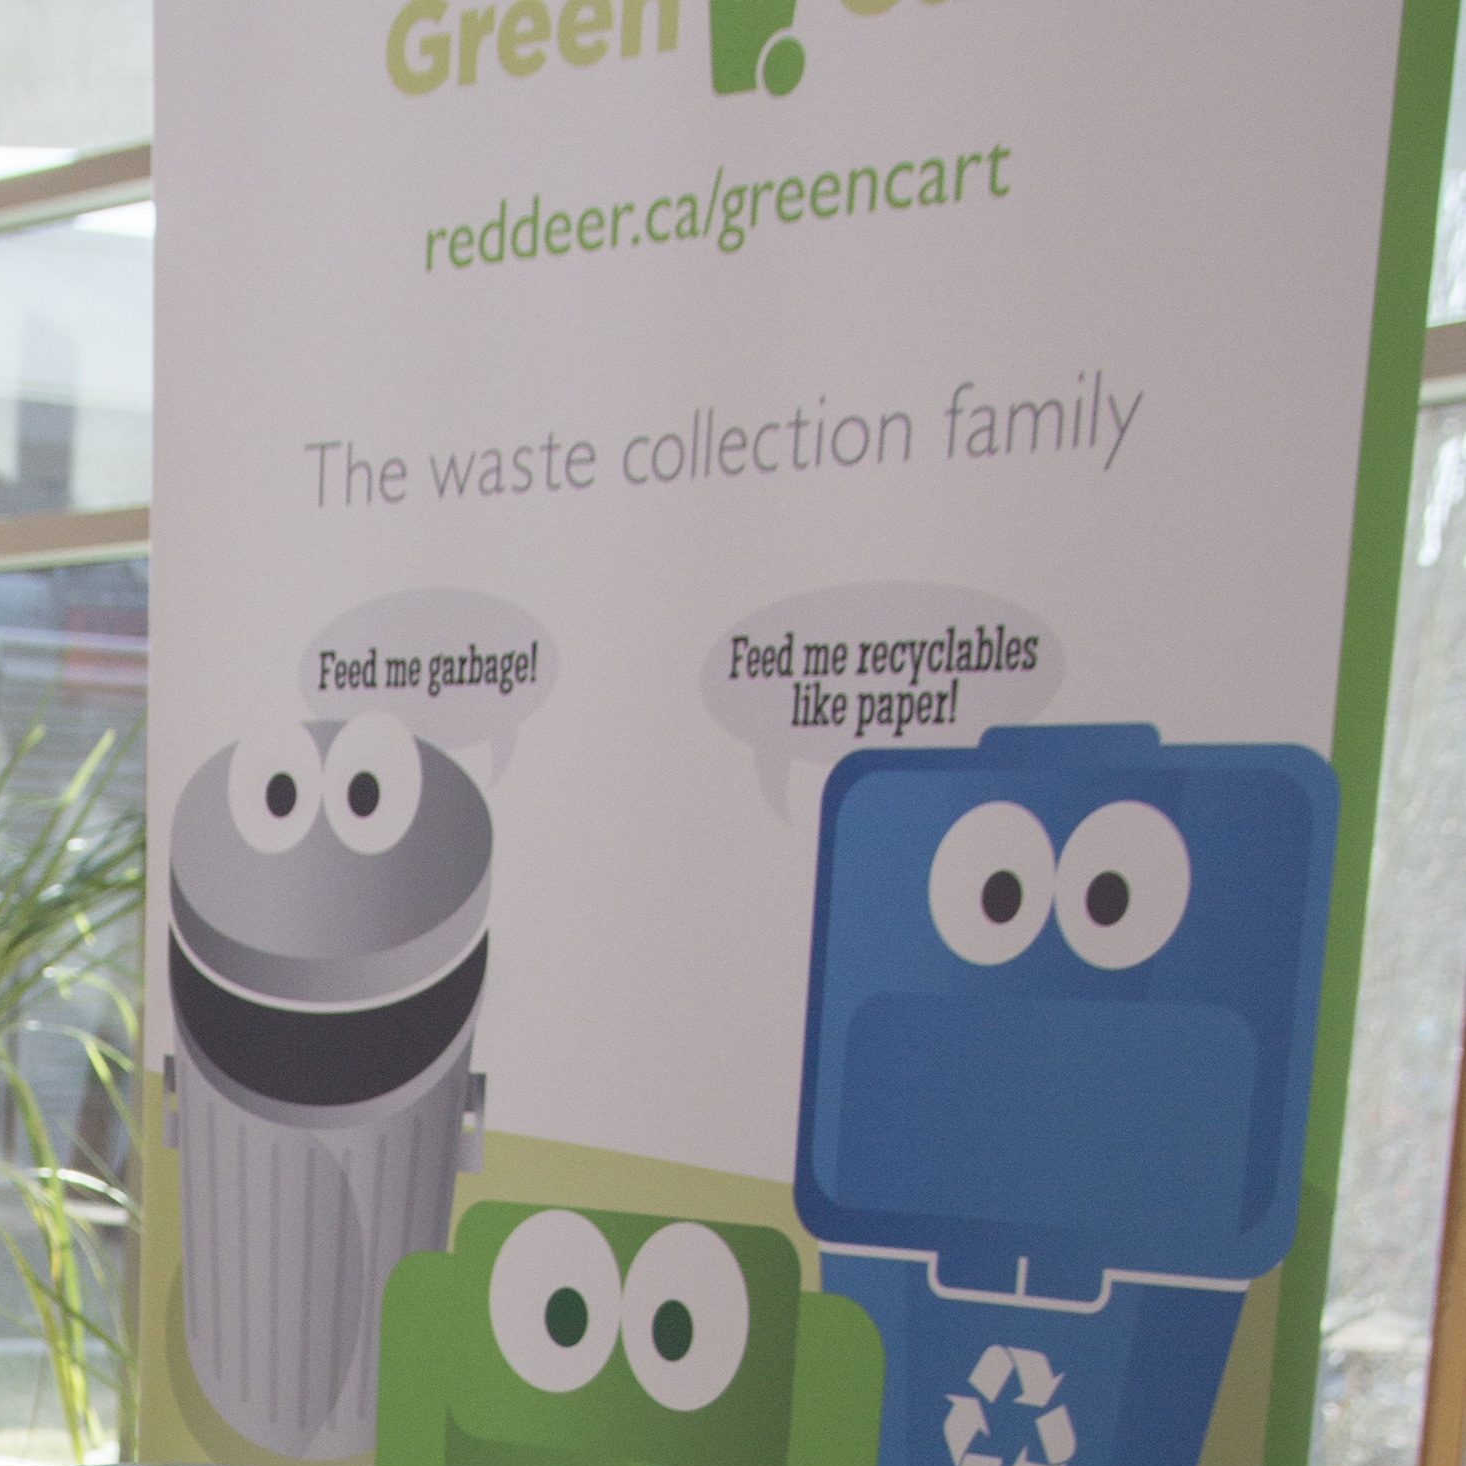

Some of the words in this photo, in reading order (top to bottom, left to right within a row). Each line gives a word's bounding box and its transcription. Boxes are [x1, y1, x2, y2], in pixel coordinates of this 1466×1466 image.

[384, 0, 680, 95] Green
[424, 141, 1011, 272] reddeer.ca/greencart
[304, 439, 408, 508] The
[428, 431, 597, 499] waste
[623, 394, 913, 485] collection
[944, 370, 1145, 472] family
[318, 649, 377, 691] Feed
[385, 655, 421, 689] me
[427, 641, 538, 697] garbage!
[729, 633, 793, 681] Feed
[803, 640, 847, 676] me
[856, 625, 1040, 684] recyclables
[790, 681, 846, 727] like
[854, 678, 959, 736] paper!
